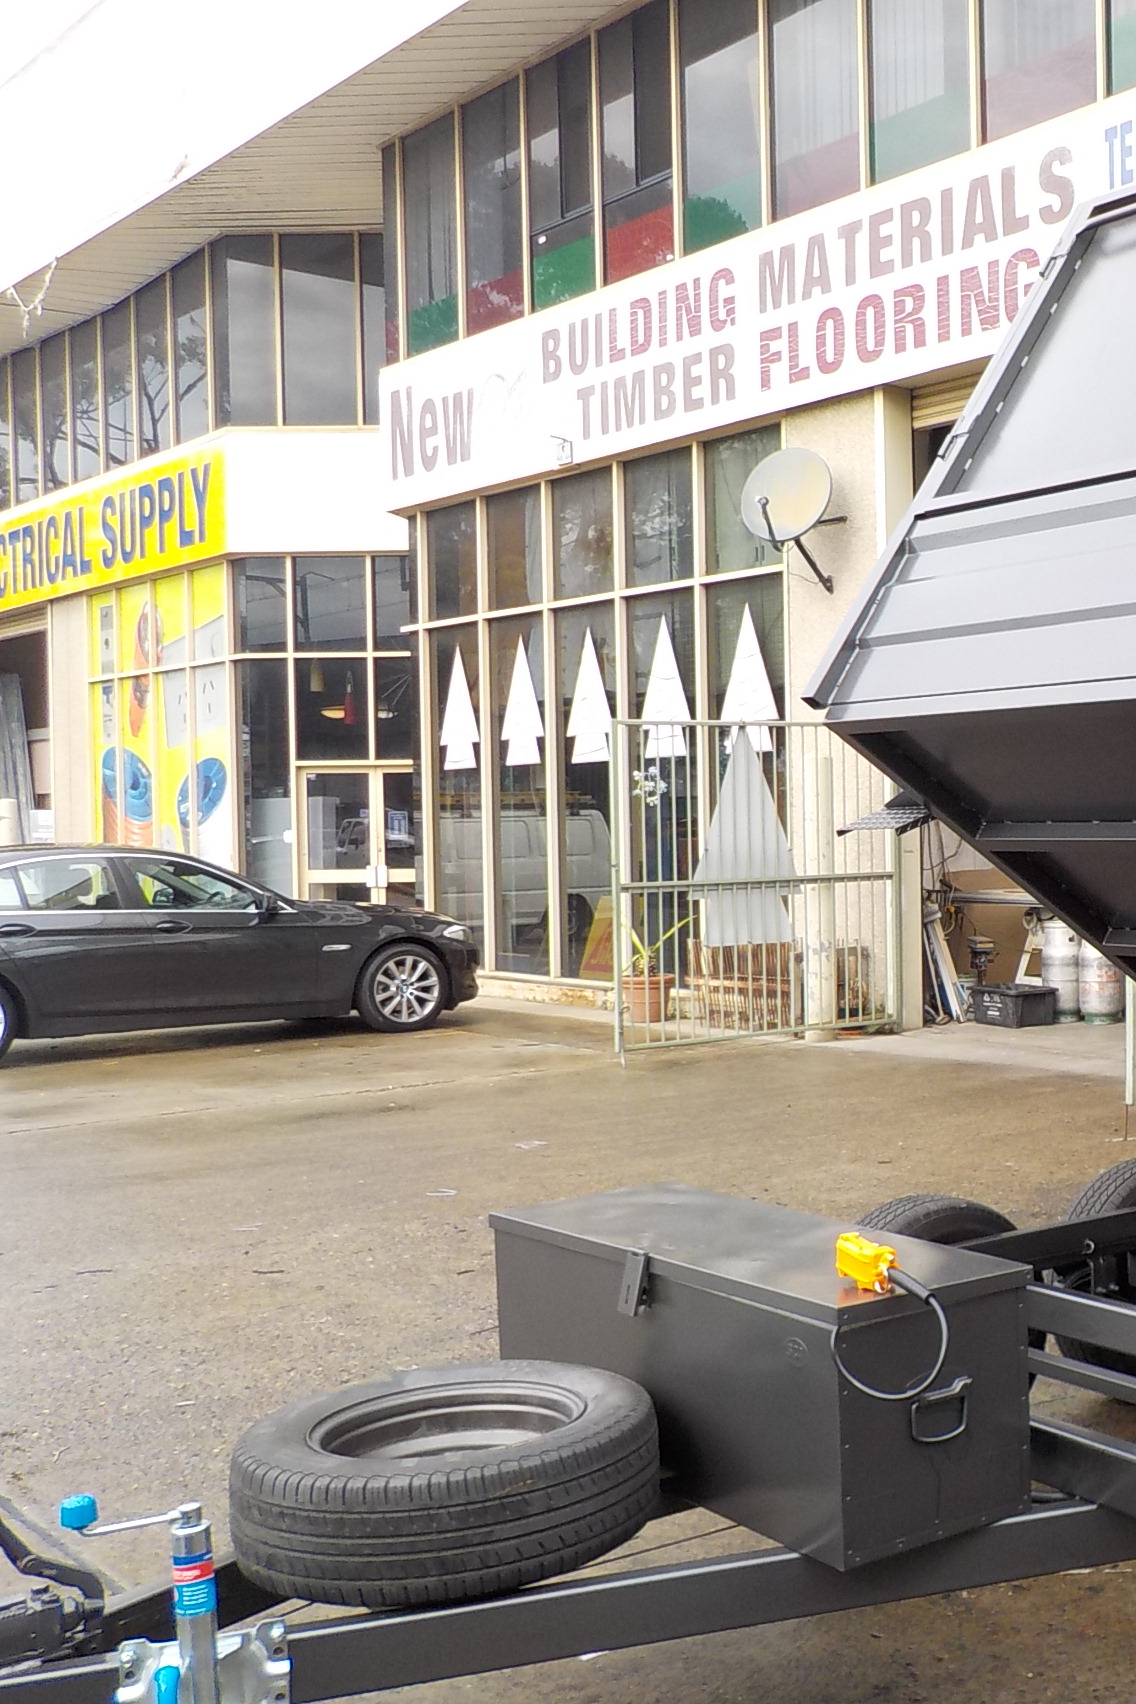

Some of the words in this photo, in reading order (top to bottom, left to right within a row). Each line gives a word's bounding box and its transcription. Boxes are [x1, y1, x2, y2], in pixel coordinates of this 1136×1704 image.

[542, 267, 736, 384] BUILDING
[758, 146, 1075, 314] MATERIALS
[577, 343, 736, 440] TIMBER
[759, 248, 1041, 392] FLOORING
[101, 462, 212, 570] SUPPLY
